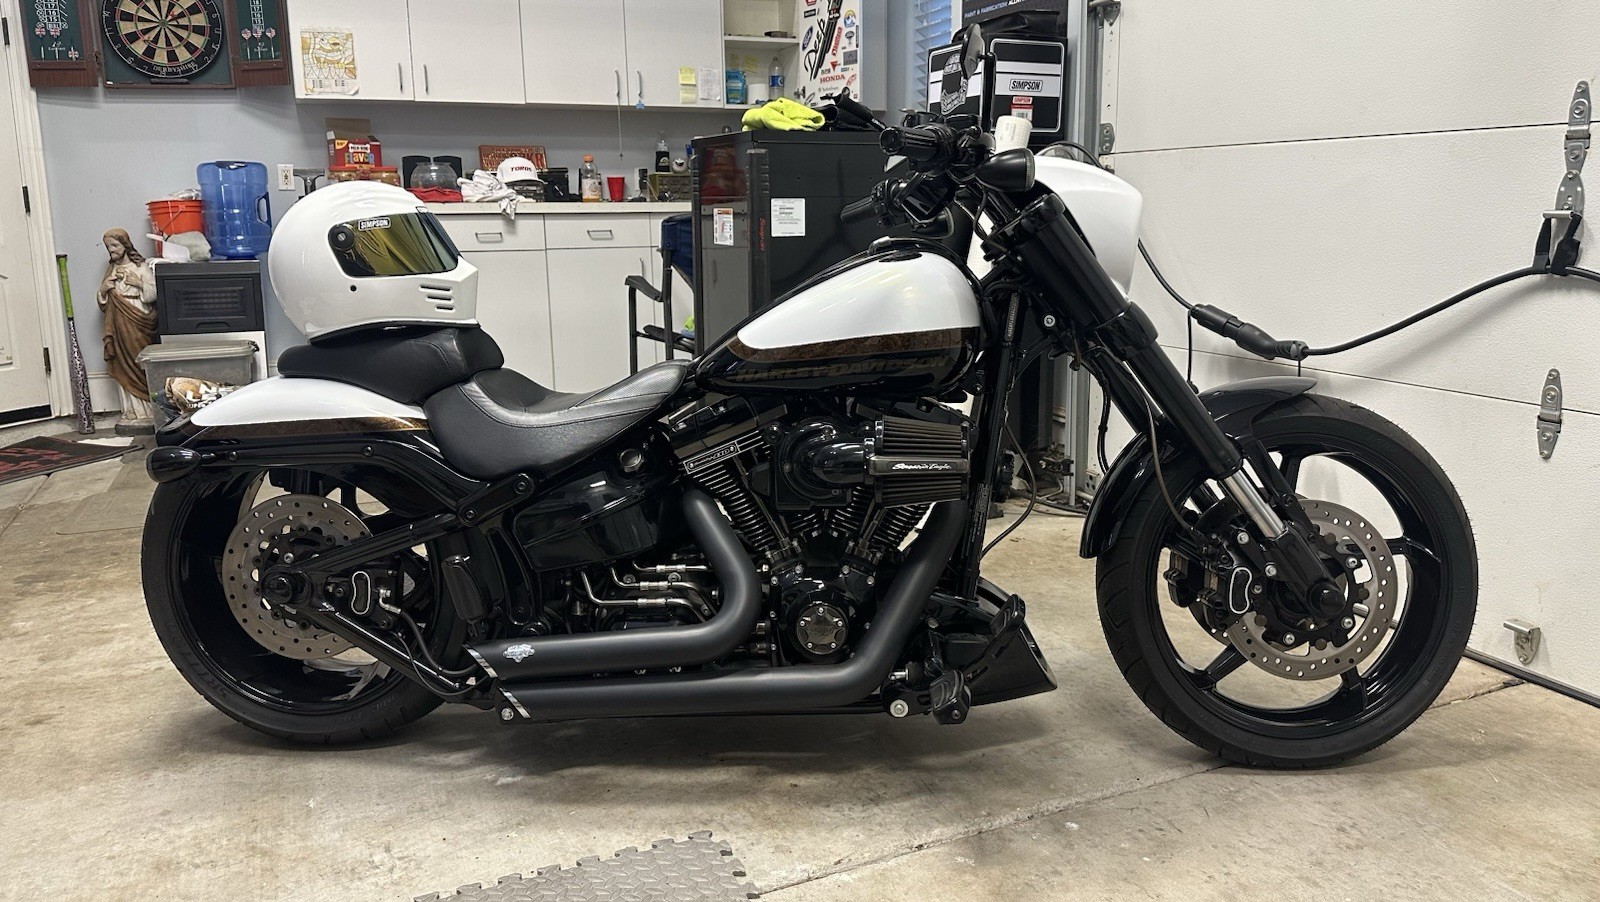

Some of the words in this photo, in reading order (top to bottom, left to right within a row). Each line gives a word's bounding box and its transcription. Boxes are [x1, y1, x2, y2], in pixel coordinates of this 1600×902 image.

[819, 74, 846, 84] HONDA
[1011, 81, 1041, 91] SIMPSON
[360, 218, 389, 230] SIMPSON
